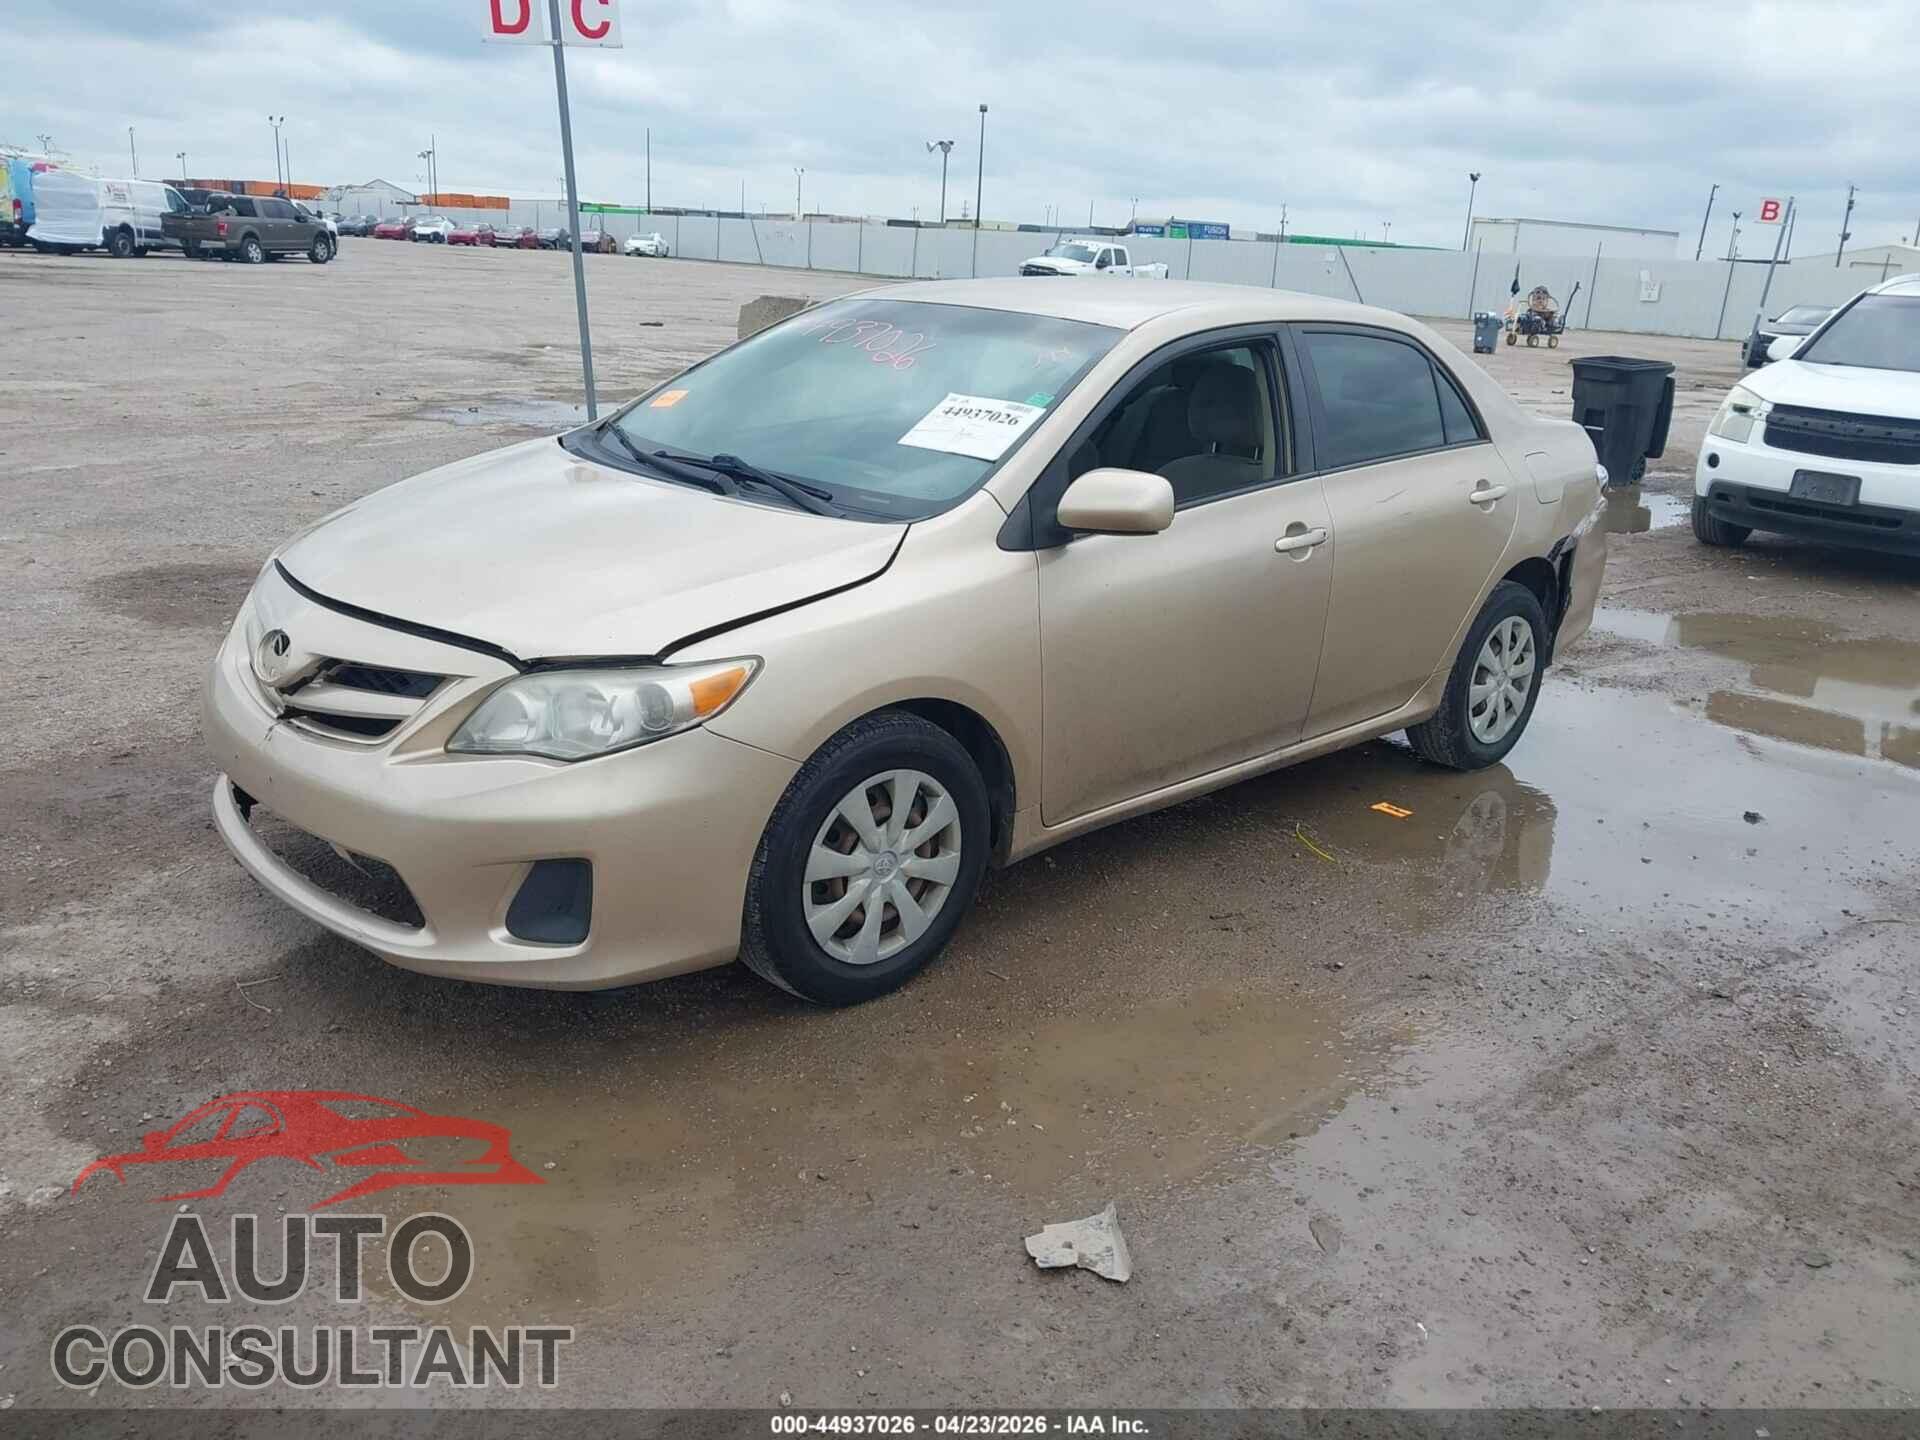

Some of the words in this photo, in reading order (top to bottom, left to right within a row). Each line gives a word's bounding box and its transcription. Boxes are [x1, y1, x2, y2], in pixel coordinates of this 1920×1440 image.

[571, 0, 611, 39] C
[1761, 200, 1780, 220] B
[942, 406, 1021, 426] 44937026
